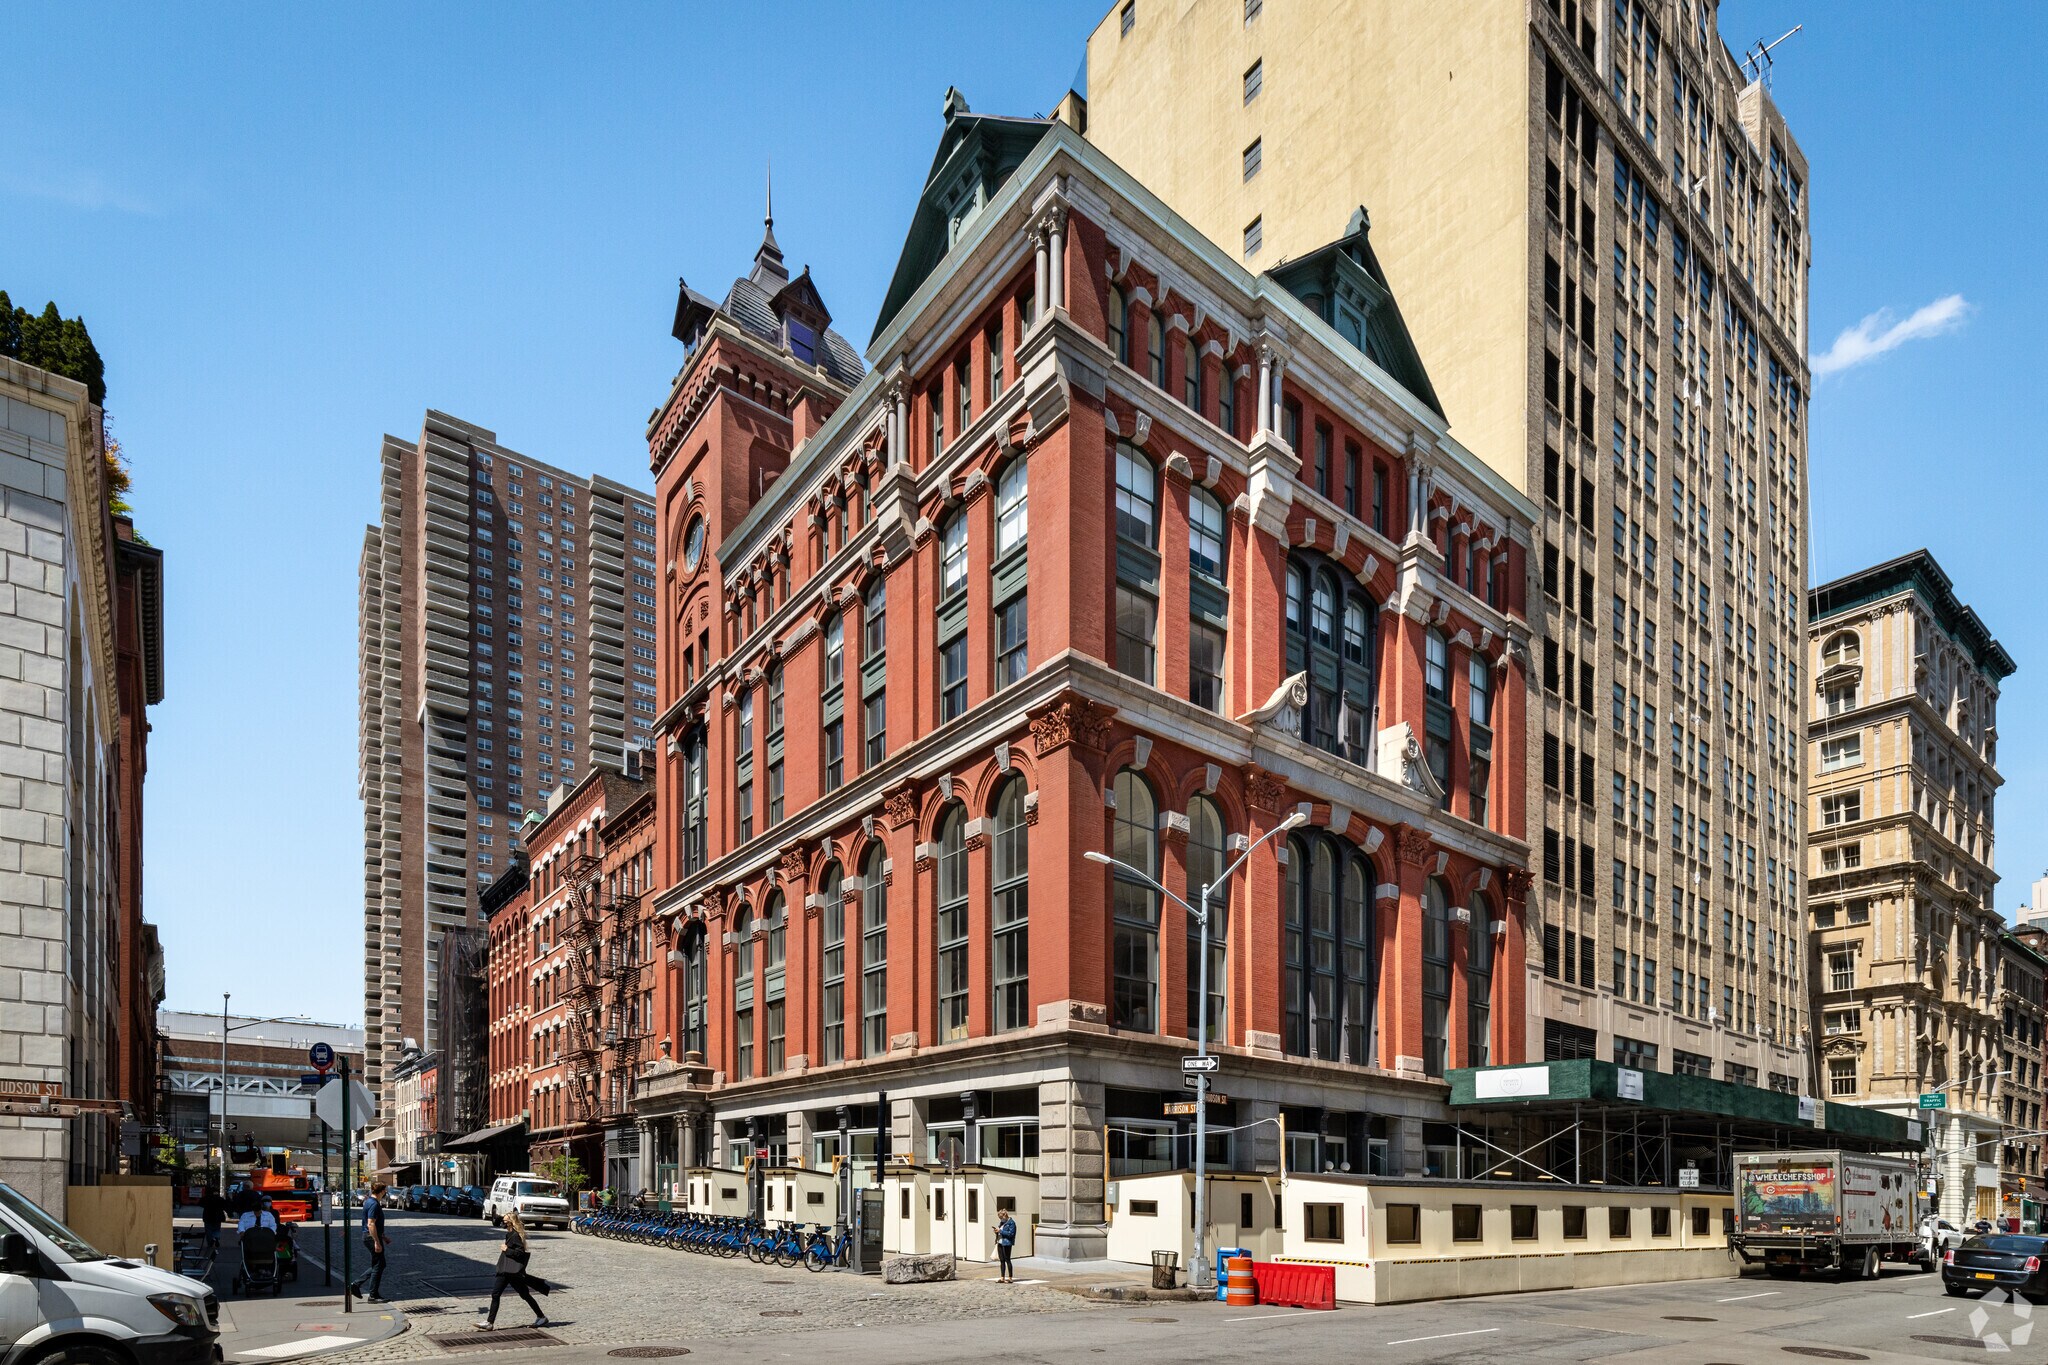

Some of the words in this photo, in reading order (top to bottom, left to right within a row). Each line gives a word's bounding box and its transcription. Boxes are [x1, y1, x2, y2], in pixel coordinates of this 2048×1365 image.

[45, 1083, 59, 1097] ST
[1164, 1103, 1189, 1114] HARRISON
[1190, 1104, 1196, 1113] ST
